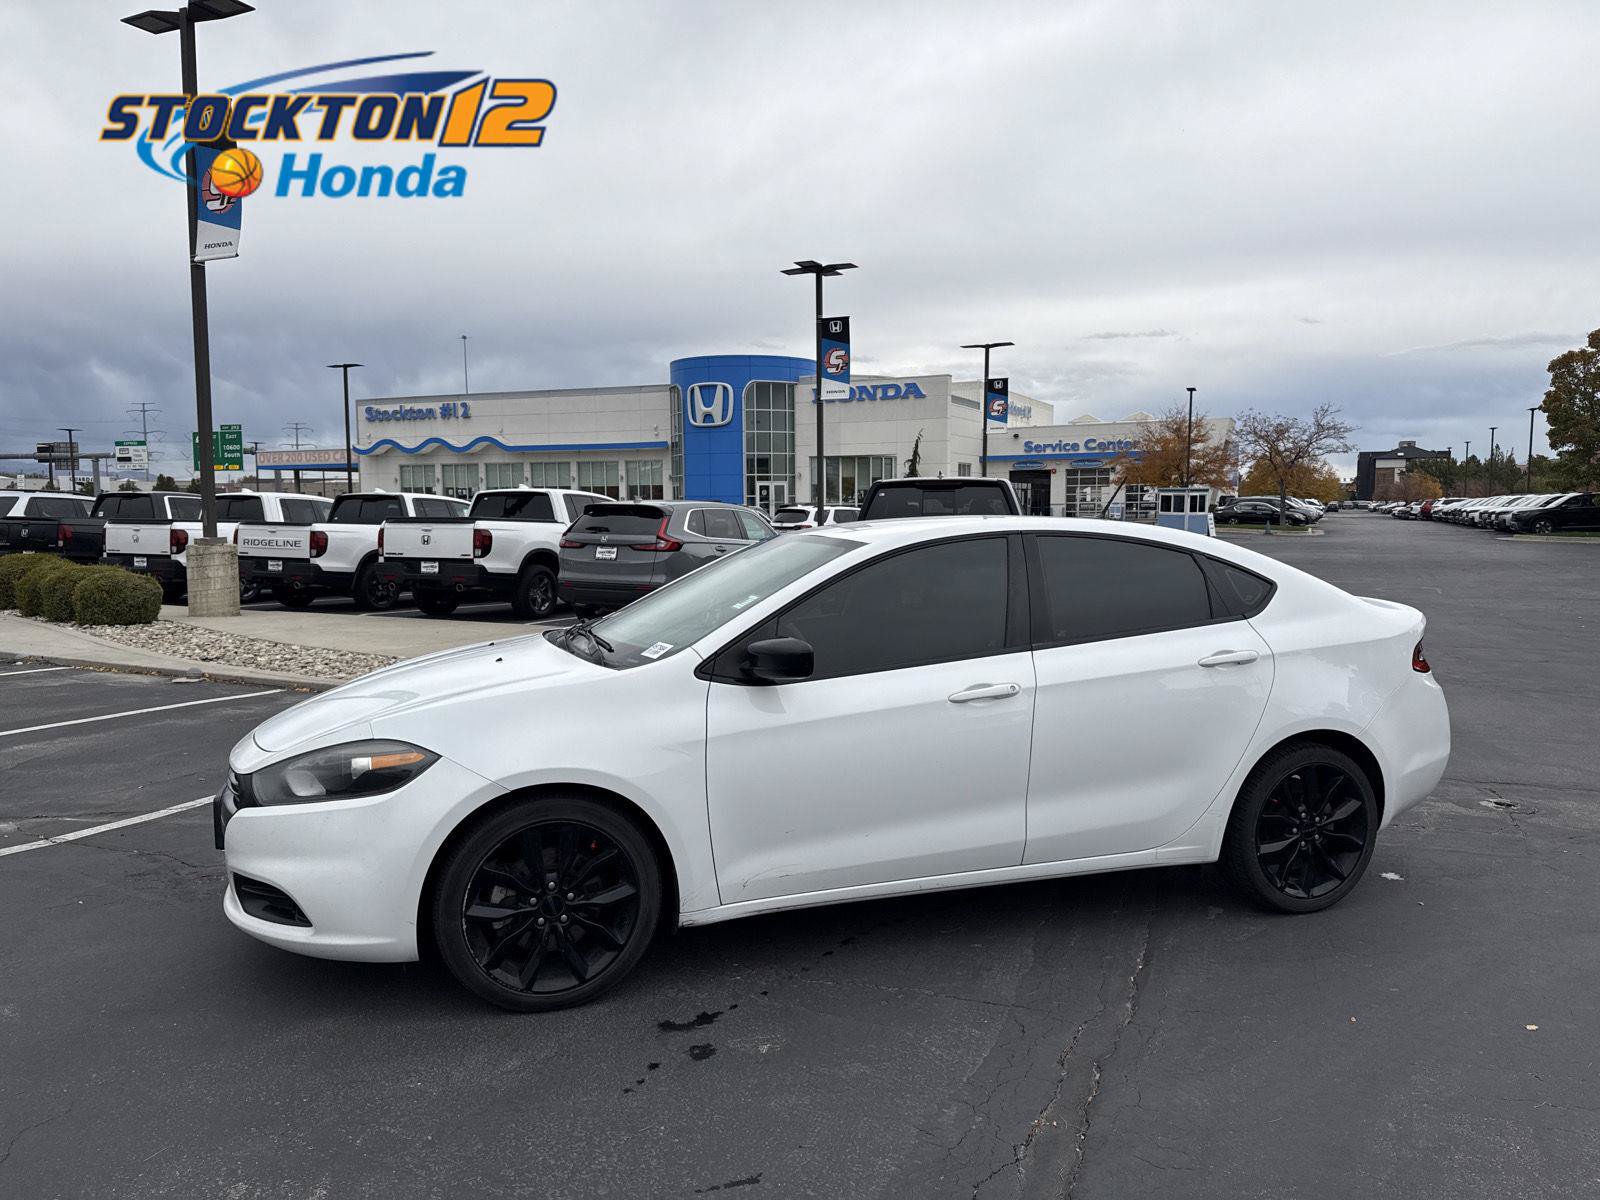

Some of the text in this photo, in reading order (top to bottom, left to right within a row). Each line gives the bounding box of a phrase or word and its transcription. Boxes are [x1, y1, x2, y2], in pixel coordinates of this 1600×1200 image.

[365, 401, 471, 422] Stockton #12
[1024, 440, 1080, 453] Service
[259, 453, 285, 464] OVER
[306, 452, 332, 462] USED
[242, 538, 303, 548] RIDGELINE
